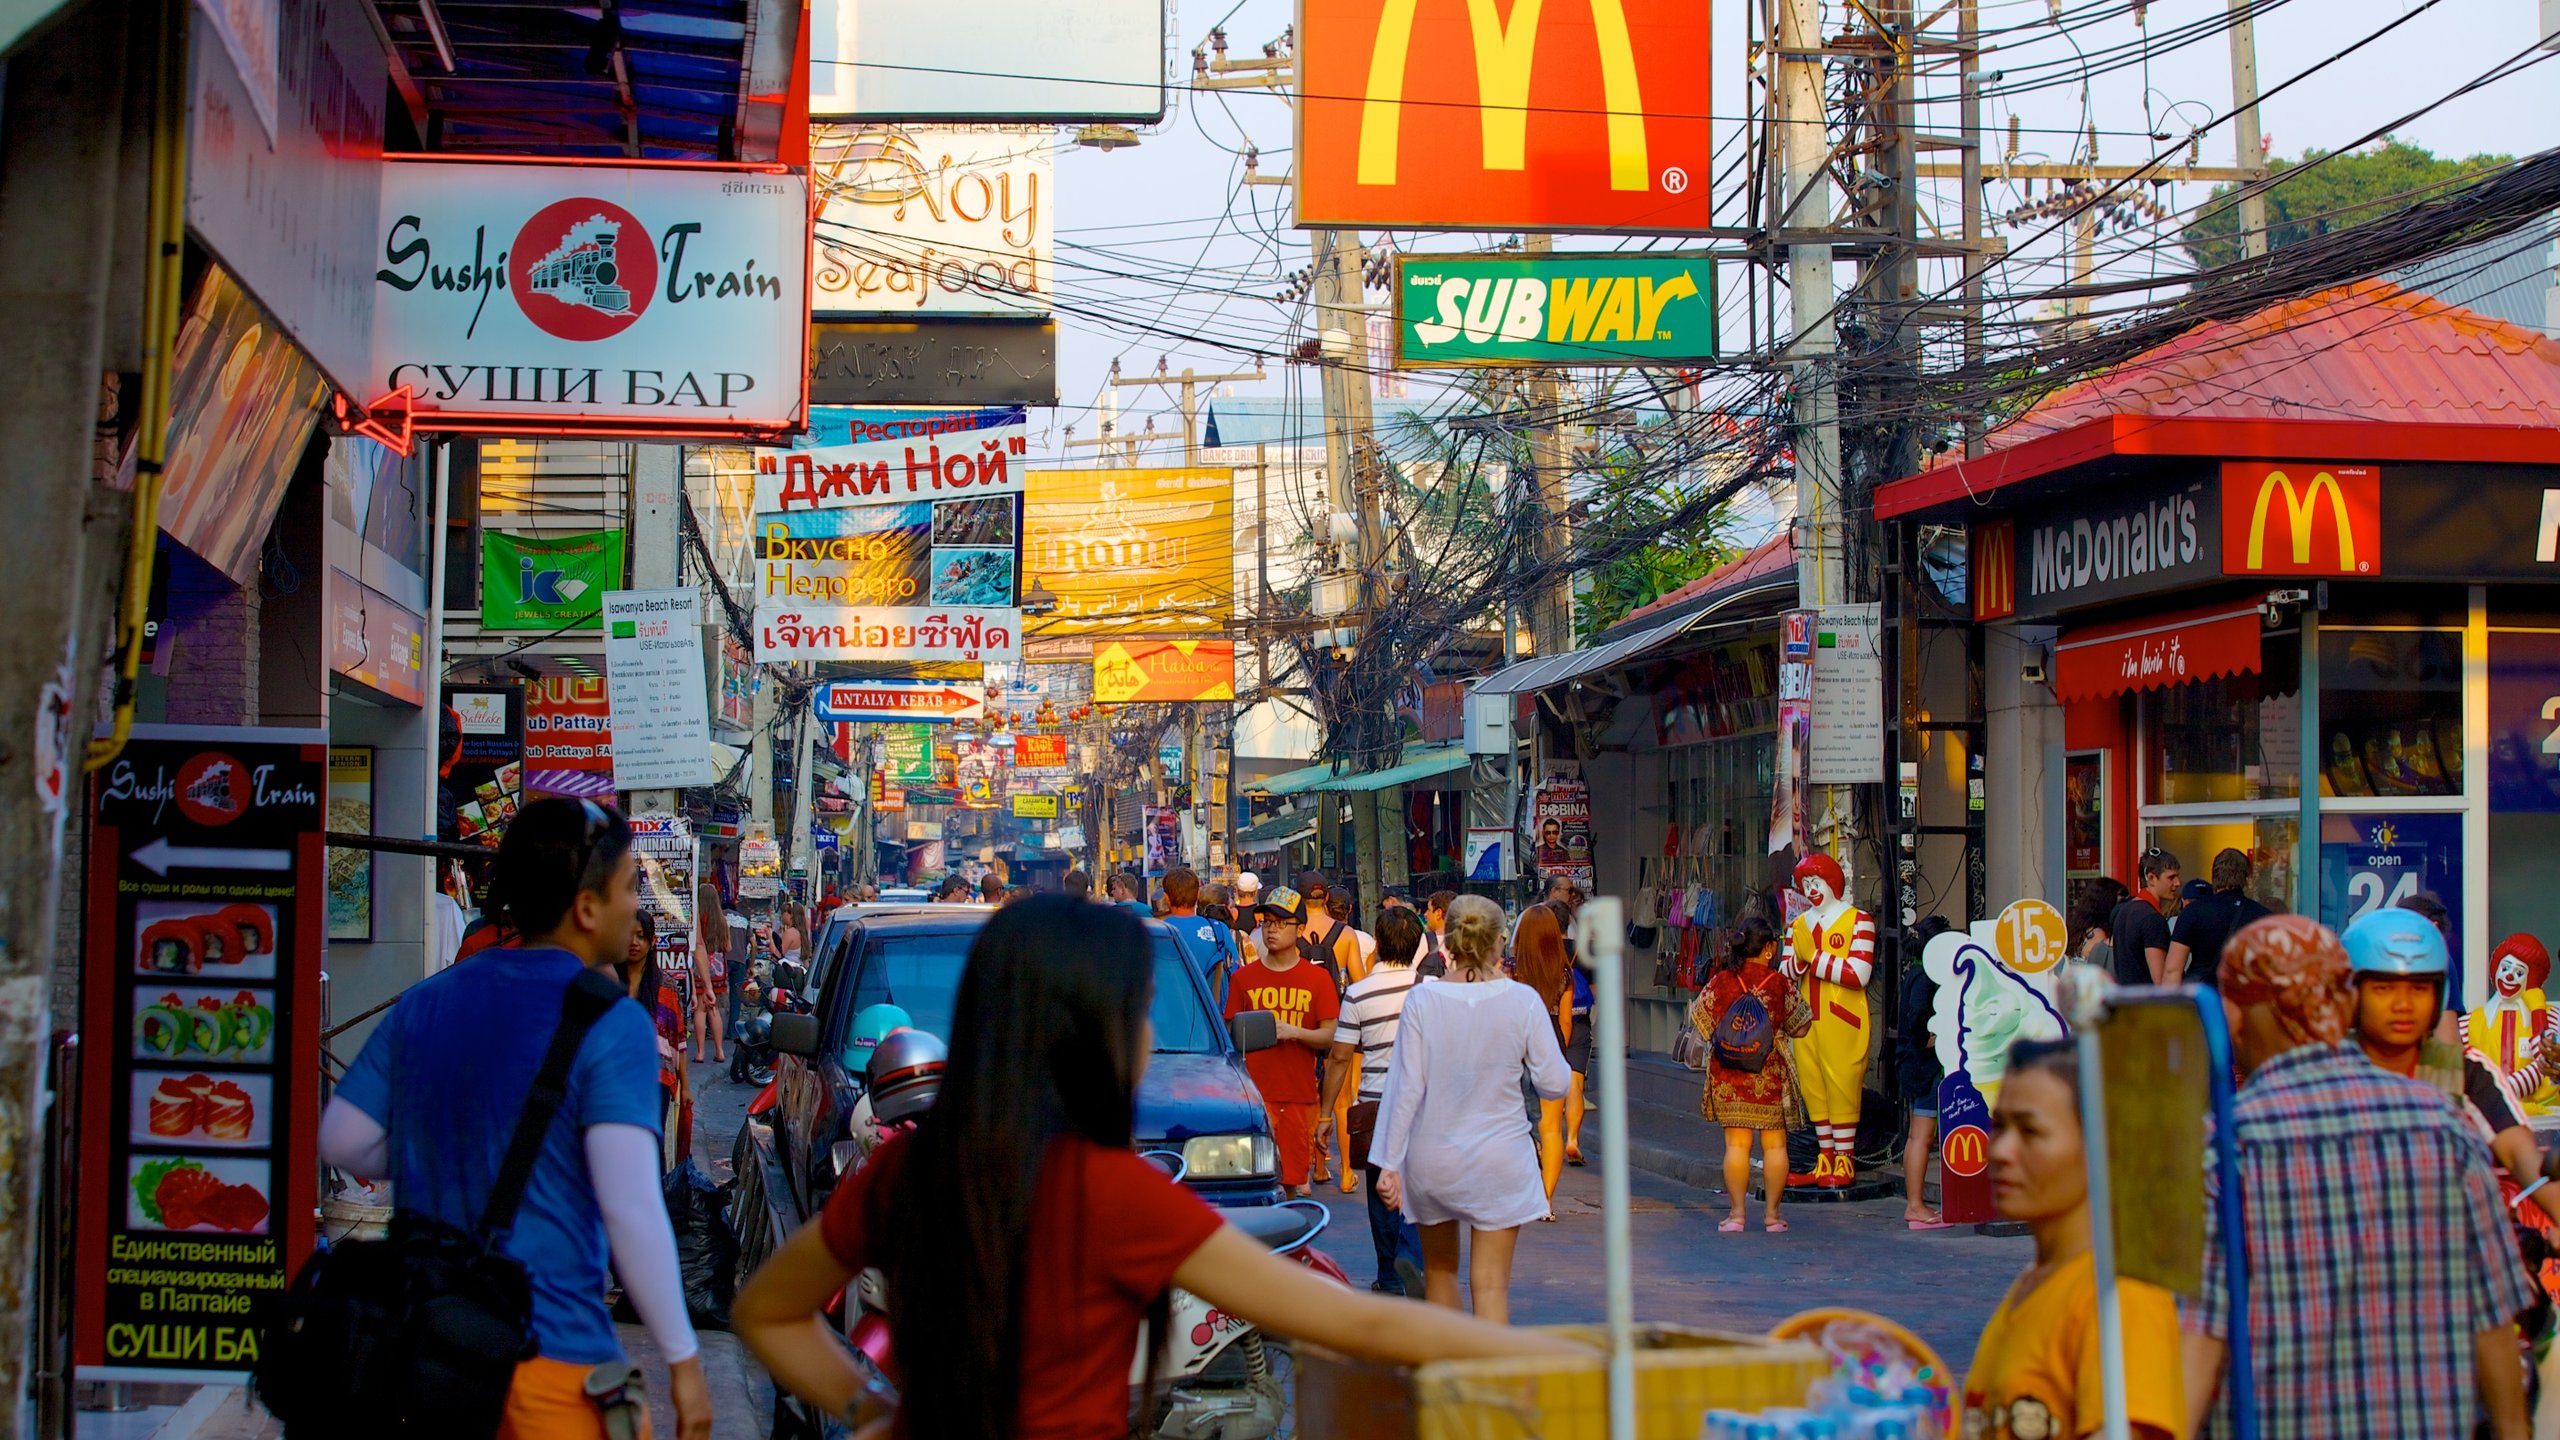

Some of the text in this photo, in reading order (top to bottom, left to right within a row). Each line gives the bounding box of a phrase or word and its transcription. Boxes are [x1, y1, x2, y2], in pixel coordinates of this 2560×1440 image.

[376, 214, 782, 340] Sushi Train
[814, 245, 1039, 308] Seafood
[1413, 268, 1698, 350] SUBWAY
[387, 362, 756, 409] СУШИ БАР
[849, 411, 978, 444] Ресторан
[1202, 448, 1233, 462] DANCE
[1234, 449, 1256, 462] DRIN
[1291, 447, 1327, 462] AMERIC
[758, 435, 1026, 512] "Джи Ной"
[766, 521, 888, 568] Вкусно
[2031, 493, 2198, 596] McDonald's
[765, 562, 919, 604] Недорого
[514, 610, 551, 620] JEWELS
[608, 597, 693, 618] Isawanya Beach Resort
[1818, 616, 1843, 630] sawanya
[1844, 614, 1861, 627] Beach
[763, 613, 1011, 662] เจ๊หน่อยซีฟู้ด
[1150, 654, 1209, 674] Haida
[2140, 640, 2166, 680] lovin'
[833, 692, 896, 706] ANTALYA
[899, 694, 944, 707] KEBAB
[528, 715, 547, 731] ub
[548, 745, 593, 759] Pattaya
[595, 745, 612, 758] FA
[100, 759, 316, 826] Sushi Train
[1539, 803, 1589, 816] BOBINA
[630, 838, 692, 851] OMINATION
[2367, 853, 2402, 869] open
[118, 879, 139, 893] Все
[141, 880, 170, 895] суши
[172, 882, 181, 893] и
[212, 883, 227, 894] по
[228, 883, 263, 897] одной
[264, 884, 296, 898] цене!
[1247, 986, 1313, 1013] YOUR
[111, 1234, 277, 1264] Единственный
[106, 1267, 286, 1291] специализированный
[139, 1287, 252, 1315] в Паттайе
[105, 1322, 265, 1363] СУШИ БА
